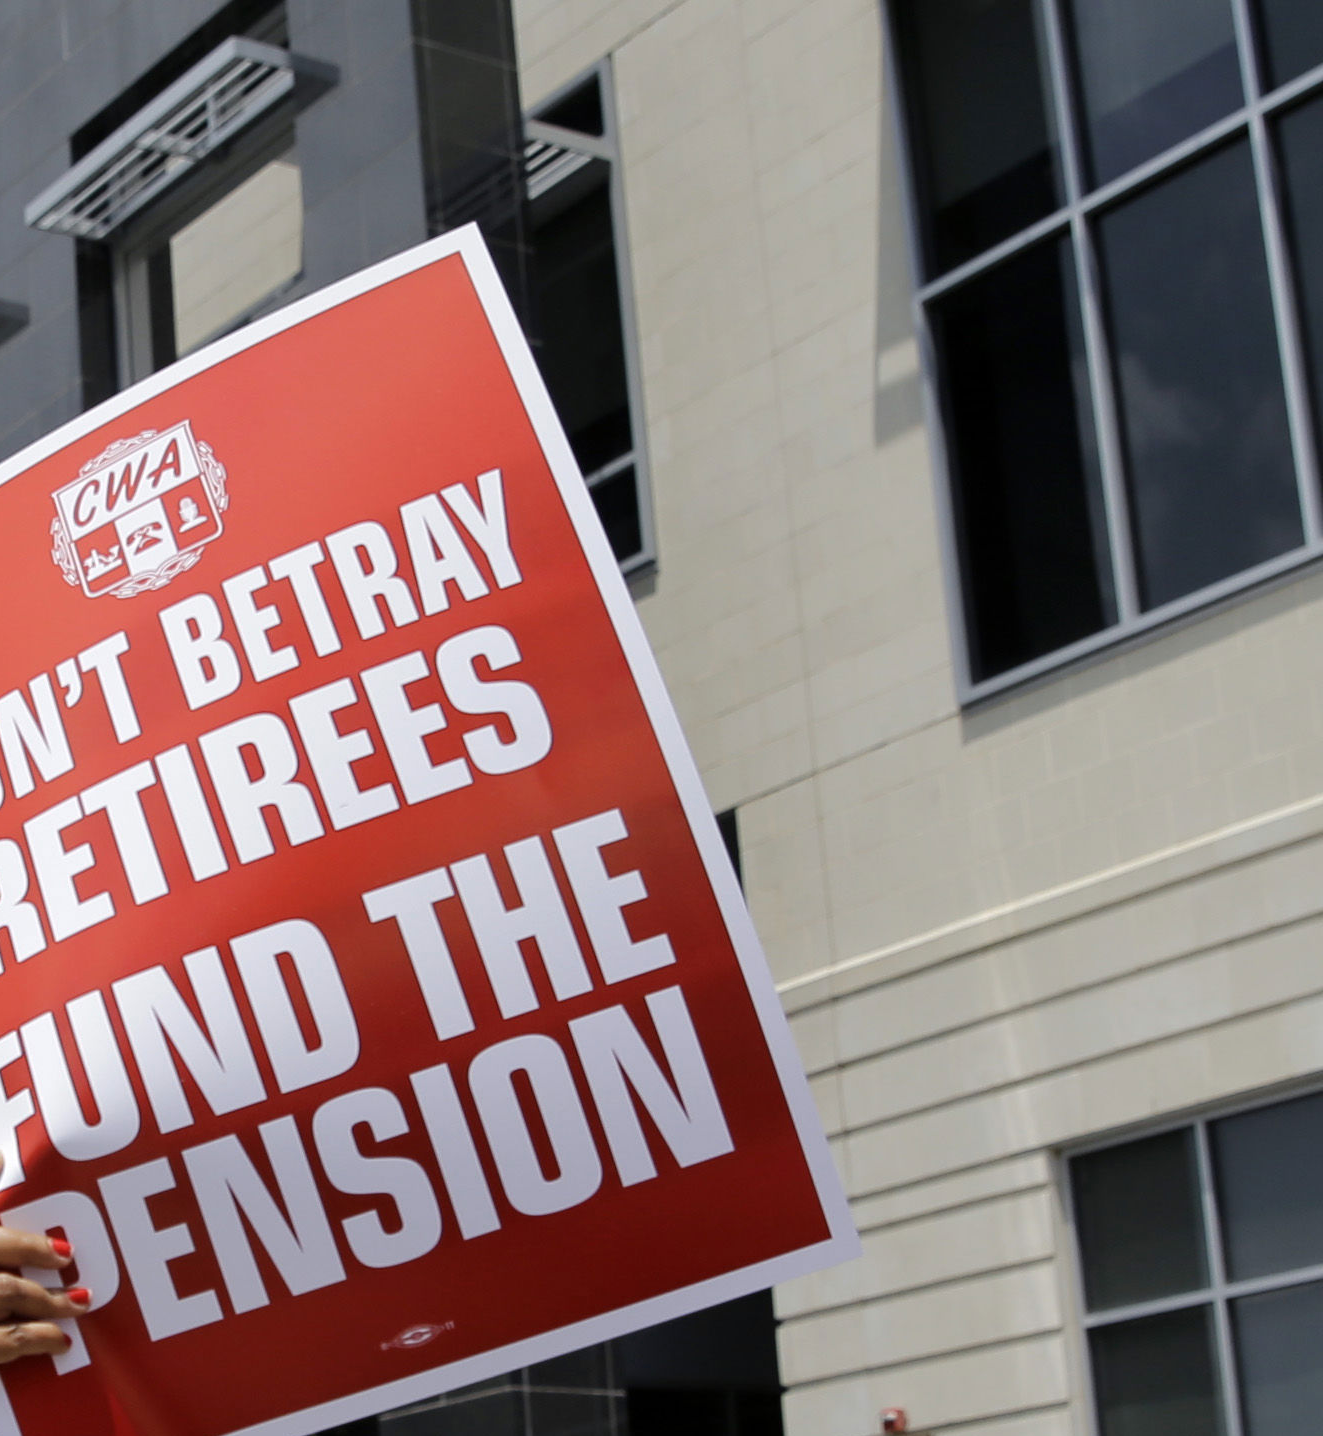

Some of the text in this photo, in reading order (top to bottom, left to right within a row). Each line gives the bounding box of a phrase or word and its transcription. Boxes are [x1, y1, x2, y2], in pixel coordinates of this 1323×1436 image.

[71, 434, 187, 530] CWA
[158, 468, 523, 709] BETRAY
[361, 807, 678, 1043] THE
[0, 985, 737, 1377] PENSION
